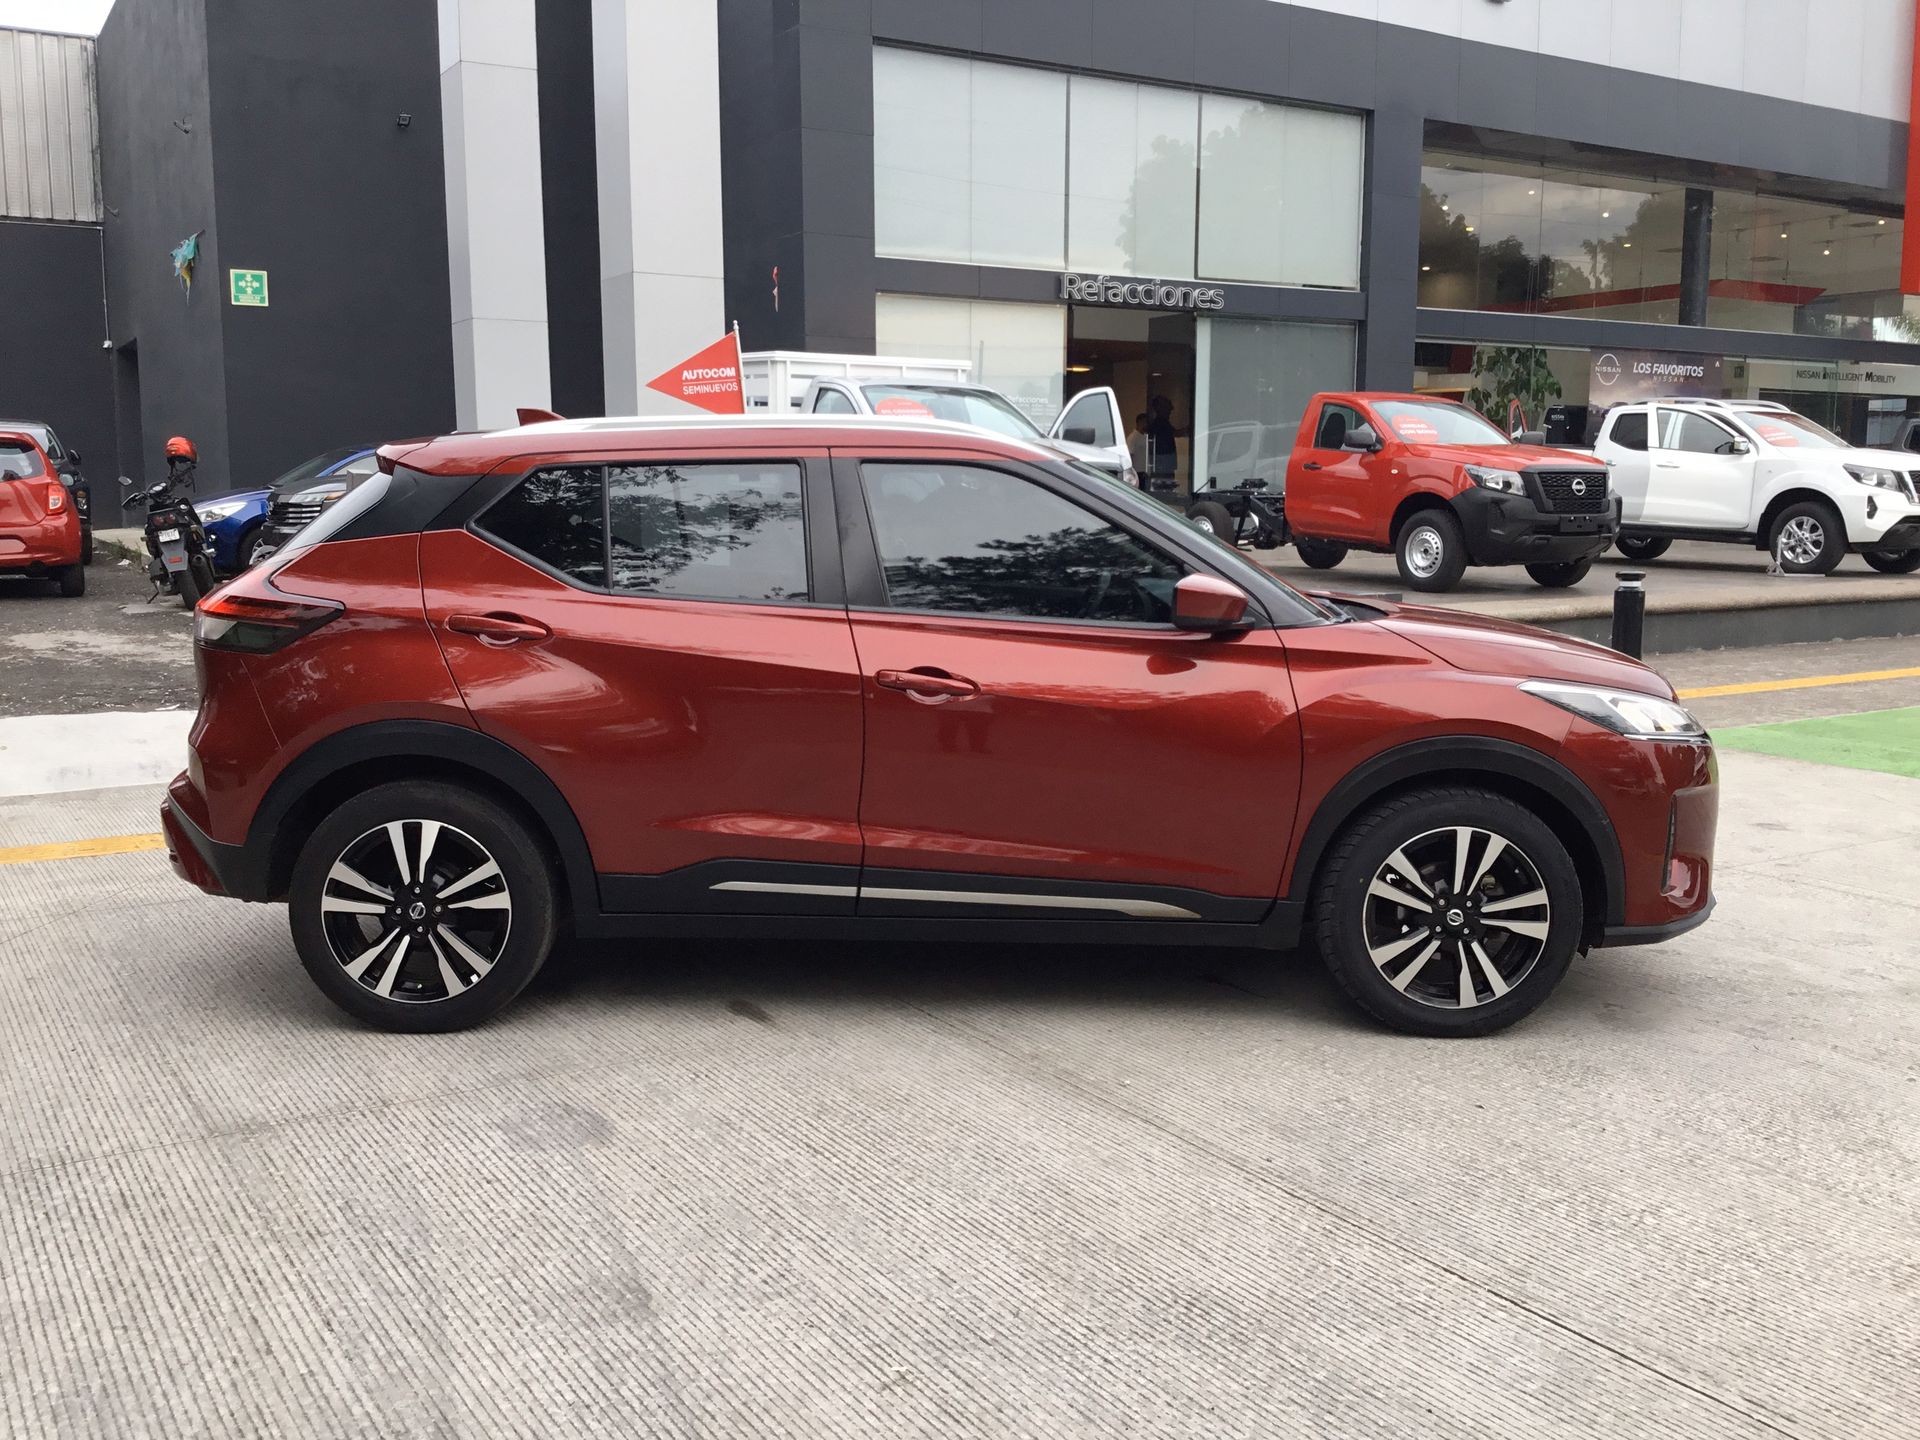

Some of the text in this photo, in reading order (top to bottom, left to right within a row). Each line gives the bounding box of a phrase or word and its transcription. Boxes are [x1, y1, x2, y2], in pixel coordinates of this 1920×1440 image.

[1060, 273, 1225, 310] Refacciones
[682, 367, 736, 380] AUTOCOM
[1633, 362, 1651, 374] LOS
[1652, 363, 1704, 377] FAVORITOS
[1796, 369, 1820, 379] NISSAN
[1864, 372, 1896, 384] MOBILITY
[1653, 375, 1685, 383] NISSAN
[683, 382, 738, 395] SEMINUEVOS
